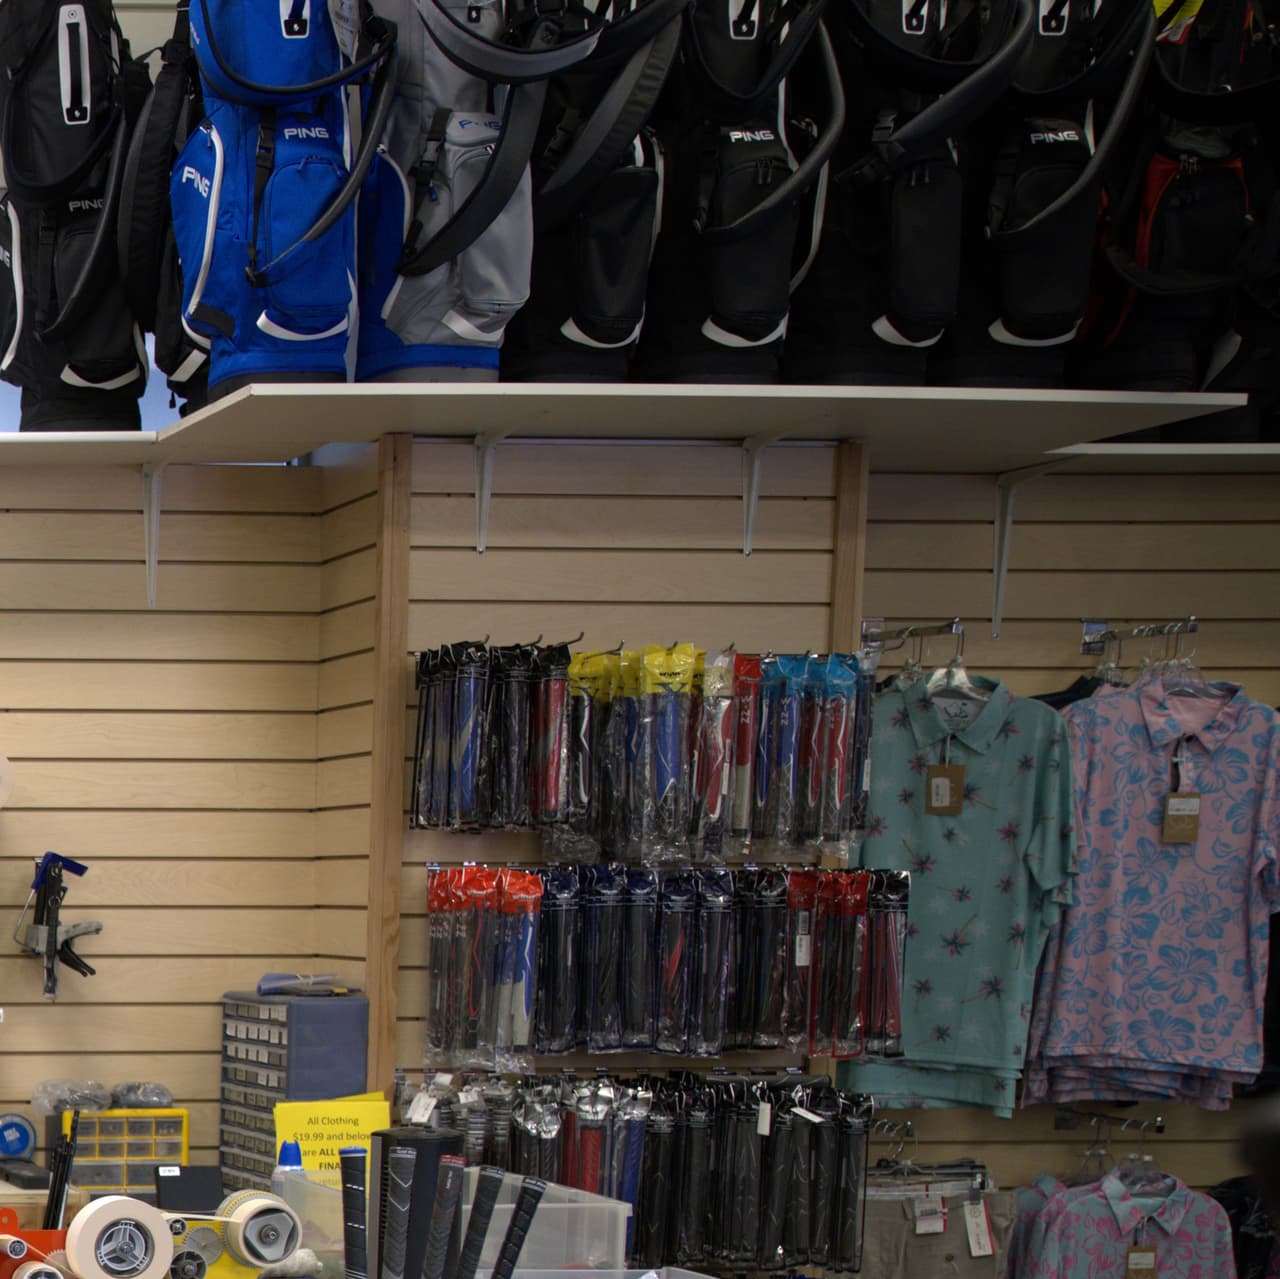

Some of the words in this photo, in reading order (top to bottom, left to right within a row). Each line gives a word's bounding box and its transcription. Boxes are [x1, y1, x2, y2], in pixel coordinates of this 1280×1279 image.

[283, 126, 329, 140] PING
[729, 128, 775, 143] PING
[1029, 130, 1079, 144] PING
[182, 165, 210, 199] PING
[307, 1117, 319, 1126] All
[321, 1117, 359, 1126] Clothing
[293, 1132, 324, 1141] $19.99
[327, 1132, 344, 1140] and
[302, 1149, 316, 1157] are
[319, 1148, 336, 1156] ALL
[319, 1162, 341, 1170] FINA
